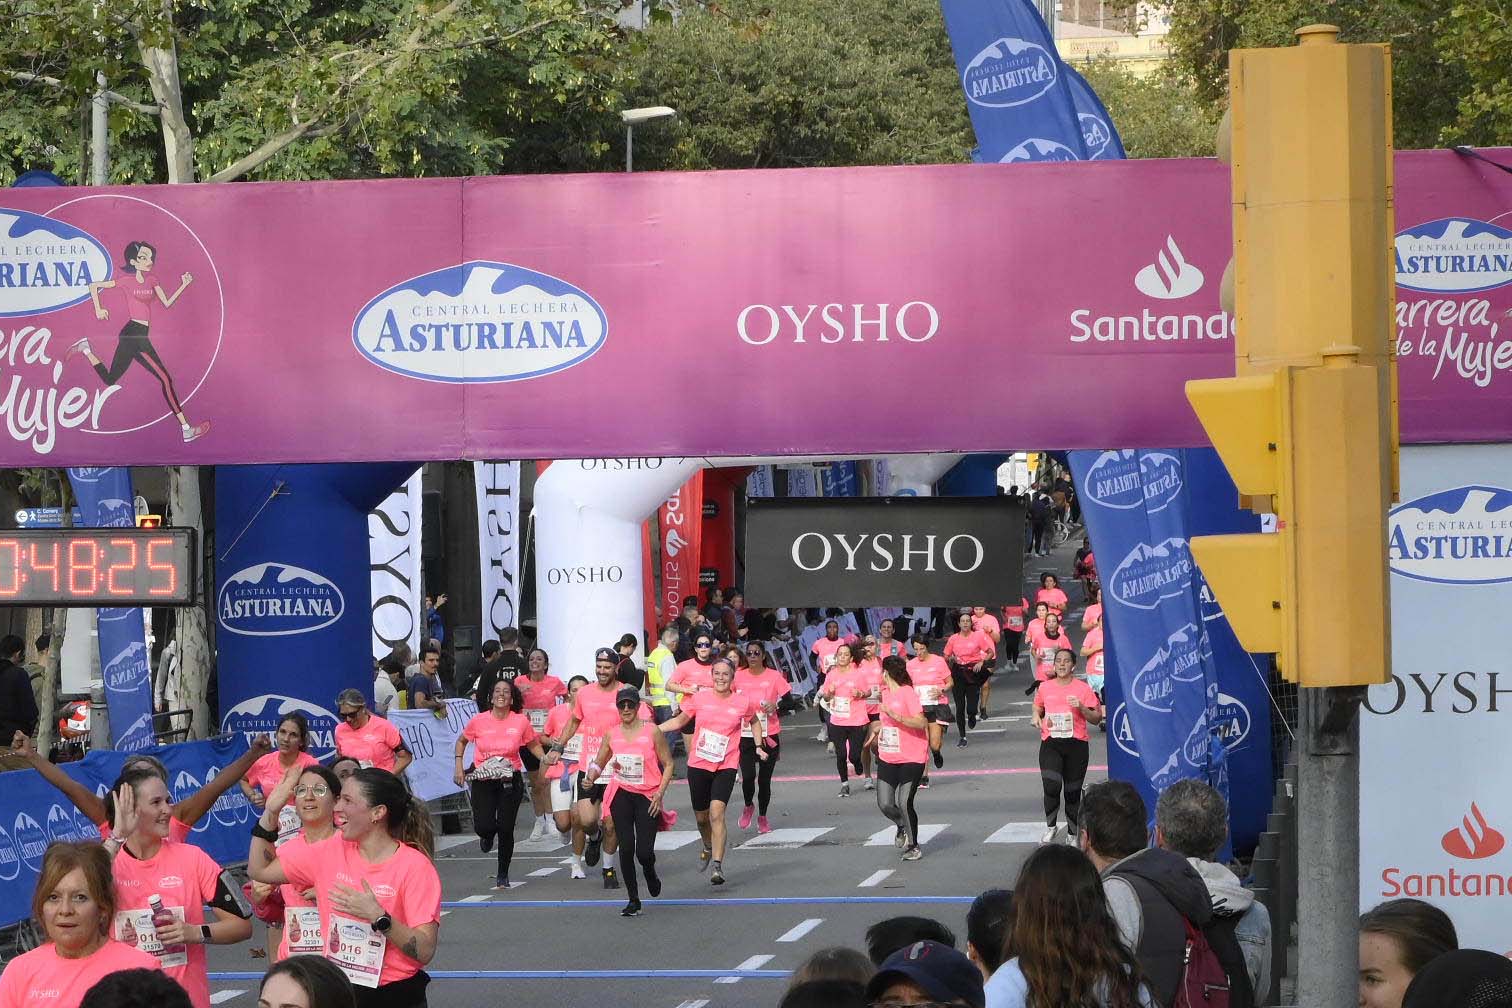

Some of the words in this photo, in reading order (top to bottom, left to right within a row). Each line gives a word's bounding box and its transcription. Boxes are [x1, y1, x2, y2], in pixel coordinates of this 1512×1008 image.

[15, 244, 87, 256] LECHERA
[1409, 243, 1461, 252] CENTRAL
[1466, 241, 1512, 251] LECHER
[1395, 247, 1512, 275] ASTURIAN
[412, 304, 490, 317] CENTRAL
[499, 302, 579, 314] LECHERA
[736, 300, 939, 345] OYSHO
[1395, 298, 1491, 328] arrera
[372, 308, 588, 353] ASTURIANA
[1069, 308, 1235, 343] Santand
[1419, 329, 1437, 357] la
[1431, 321, 1512, 388] Muje
[1416, 519, 1485, 531] CENTRAL
[791, 532, 984, 573] OYSHO
[1388, 524, 1512, 561] ASTURI
[547, 565, 623, 585] OYSHO
[222, 592, 336, 620] ASTURIANA
[235, 587, 278, 597] CENTRAL
[1362, 671, 1512, 715] OYSH
[1381, 867, 1512, 898] Santan
[140, 934, 161, 943] 01
[303, 929, 321, 938] 016
[340, 942, 362, 955] 016
